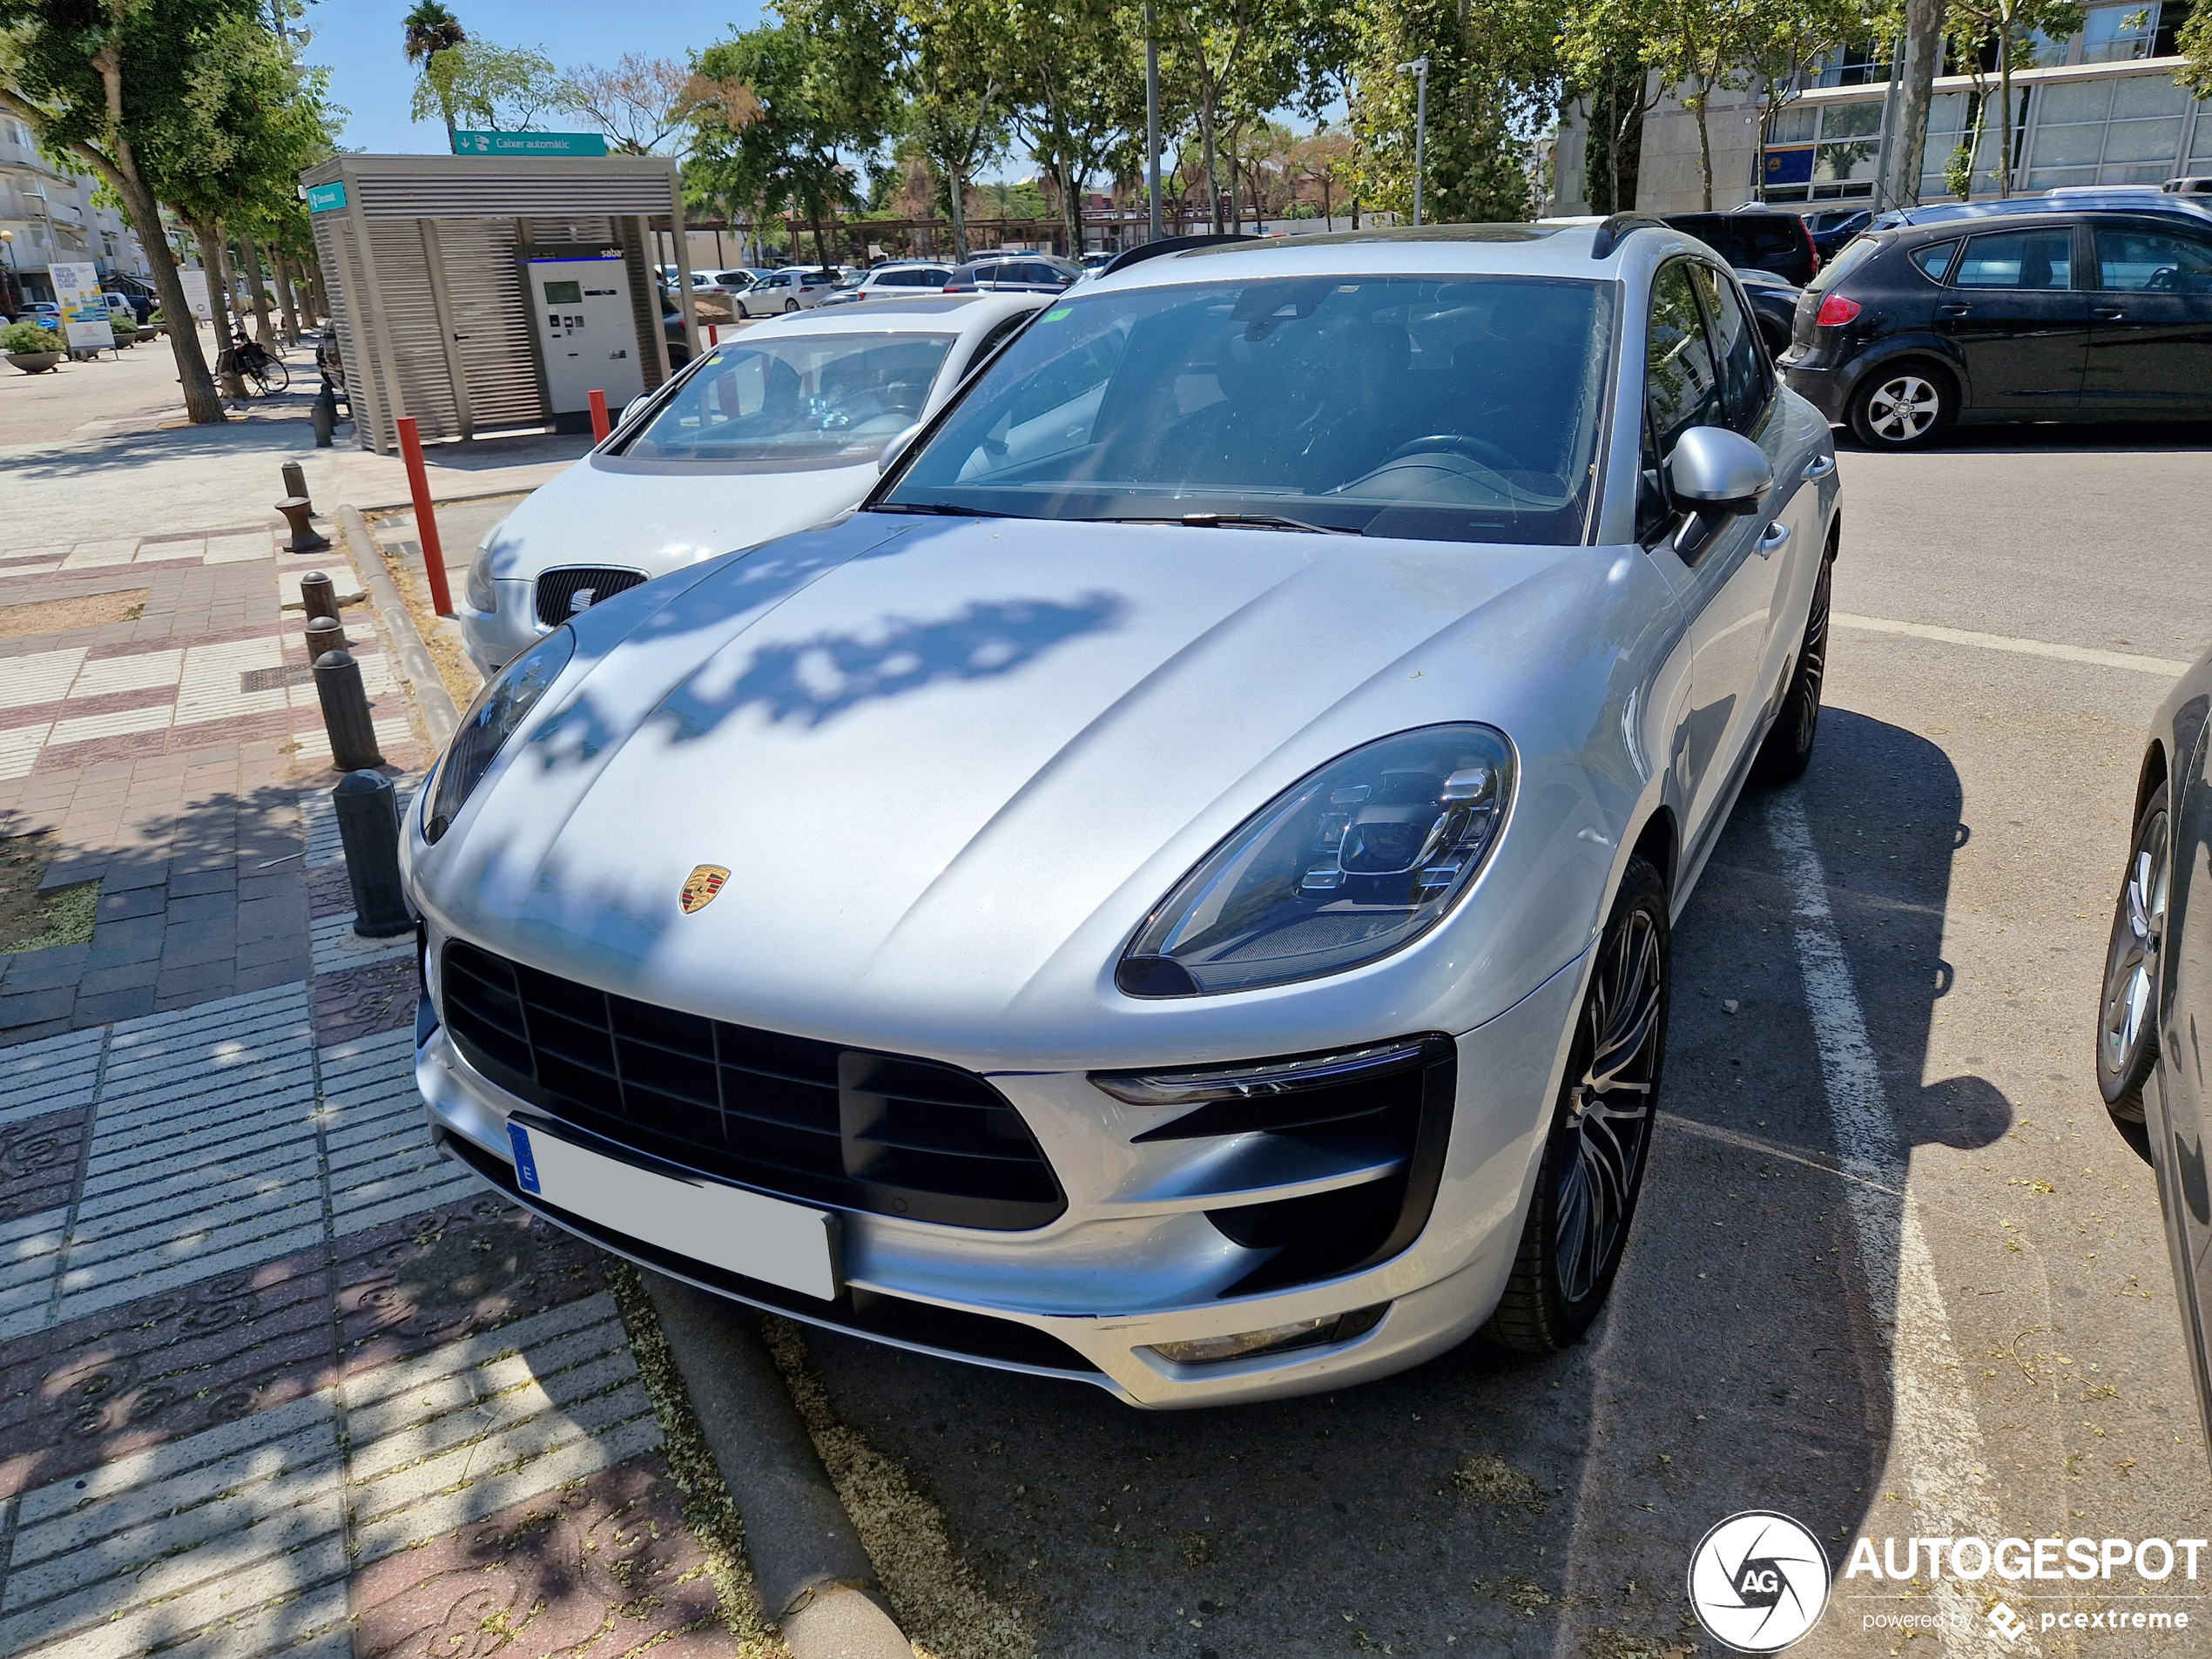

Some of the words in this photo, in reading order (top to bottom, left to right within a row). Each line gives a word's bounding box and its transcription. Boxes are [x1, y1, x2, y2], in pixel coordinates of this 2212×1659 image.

[496, 138, 524, 148] Caixer
[526, 139, 570, 149] automàtic
[601, 247, 622, 258] saba
[523, 1165, 534, 1182] E
